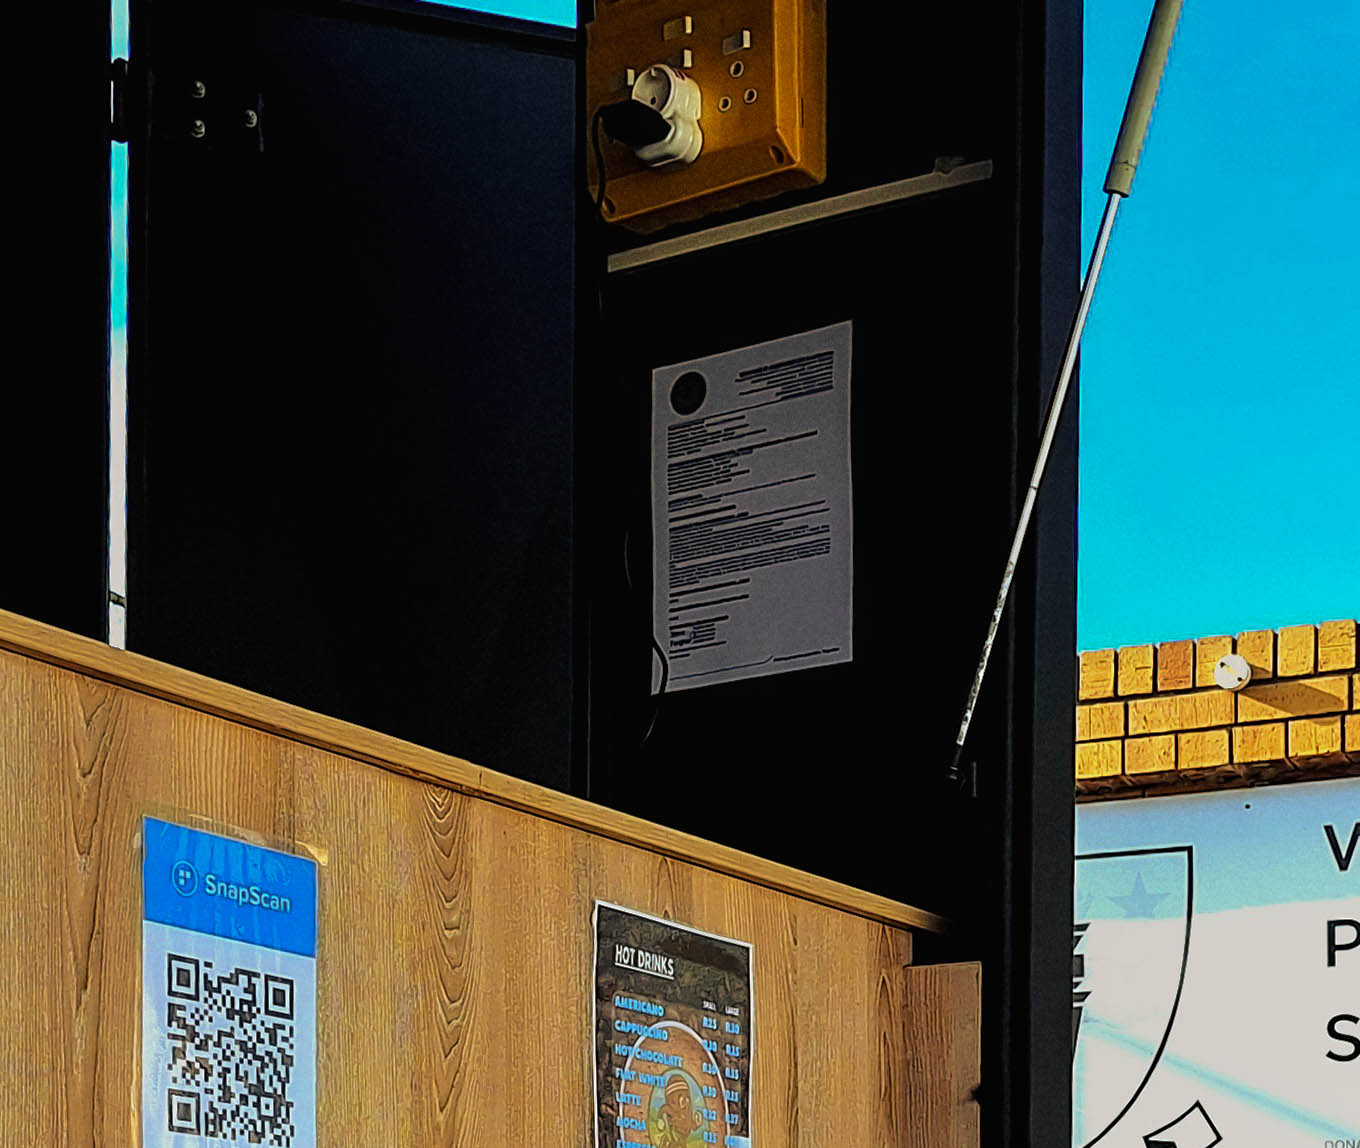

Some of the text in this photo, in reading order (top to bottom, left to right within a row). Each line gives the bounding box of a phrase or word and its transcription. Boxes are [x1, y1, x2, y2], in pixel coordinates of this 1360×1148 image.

[204, 873, 291, 913] SnapScan
[615, 944, 675, 976] HOT DRINKS
[615, 1044, 633, 1057] HOT
